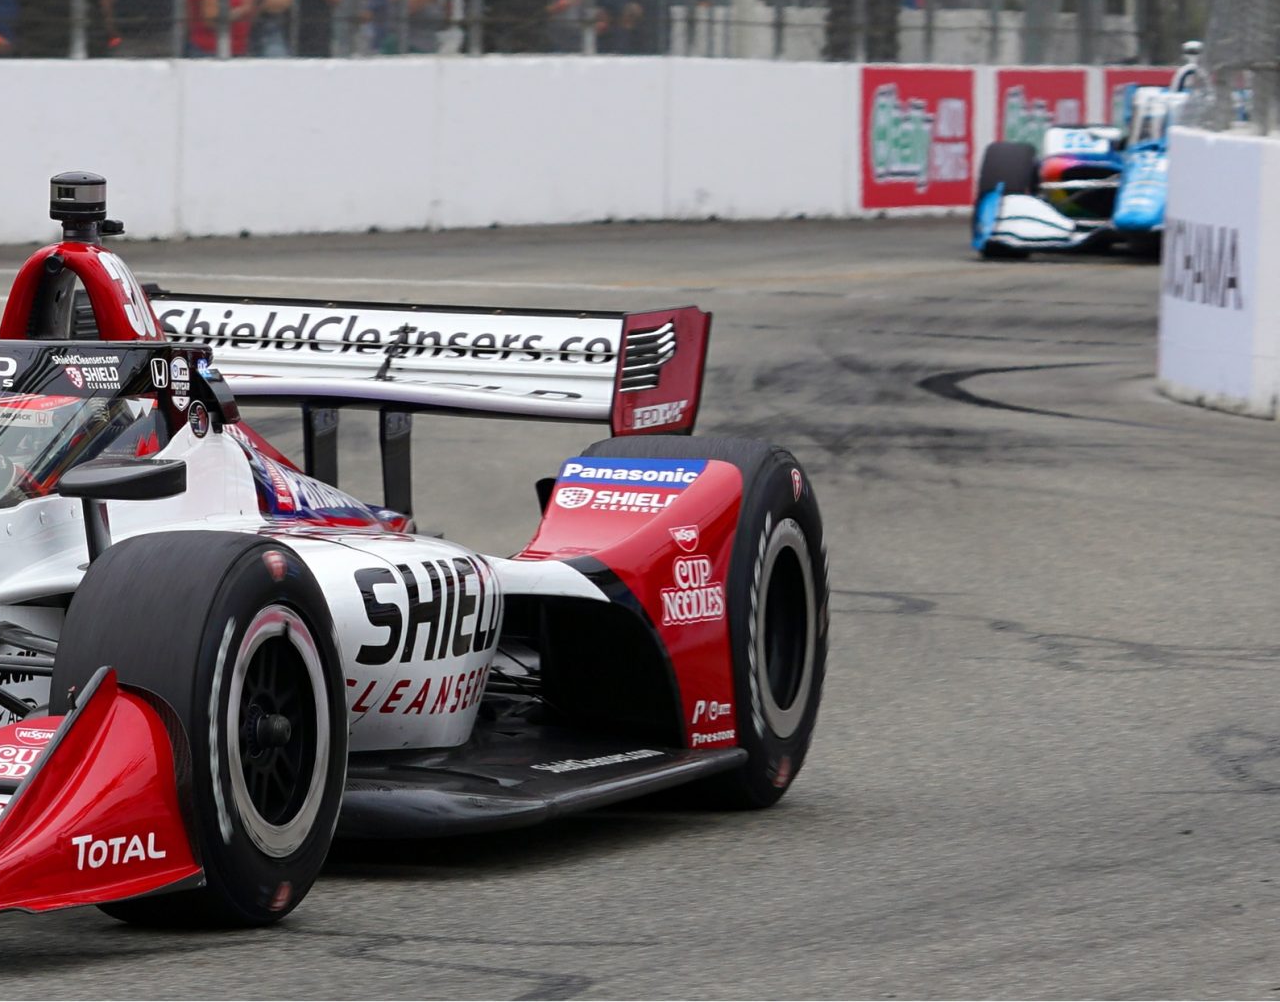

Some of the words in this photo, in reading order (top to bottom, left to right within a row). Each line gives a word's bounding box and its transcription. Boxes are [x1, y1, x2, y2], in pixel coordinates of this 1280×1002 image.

[97, 251, 156, 339] 30
[51, 354, 120, 366] ShieldCleansers.com
[81, 366, 119, 382] SHIELD
[562, 463, 698, 485] Panasonic
[675, 557, 711, 590] CUP
[662, 585, 724, 622] NOODLES
[19, 729, 54, 740] NISSIN
[691, 729, 736, 747] Firestone
[71, 832, 167, 871] TOTAL
